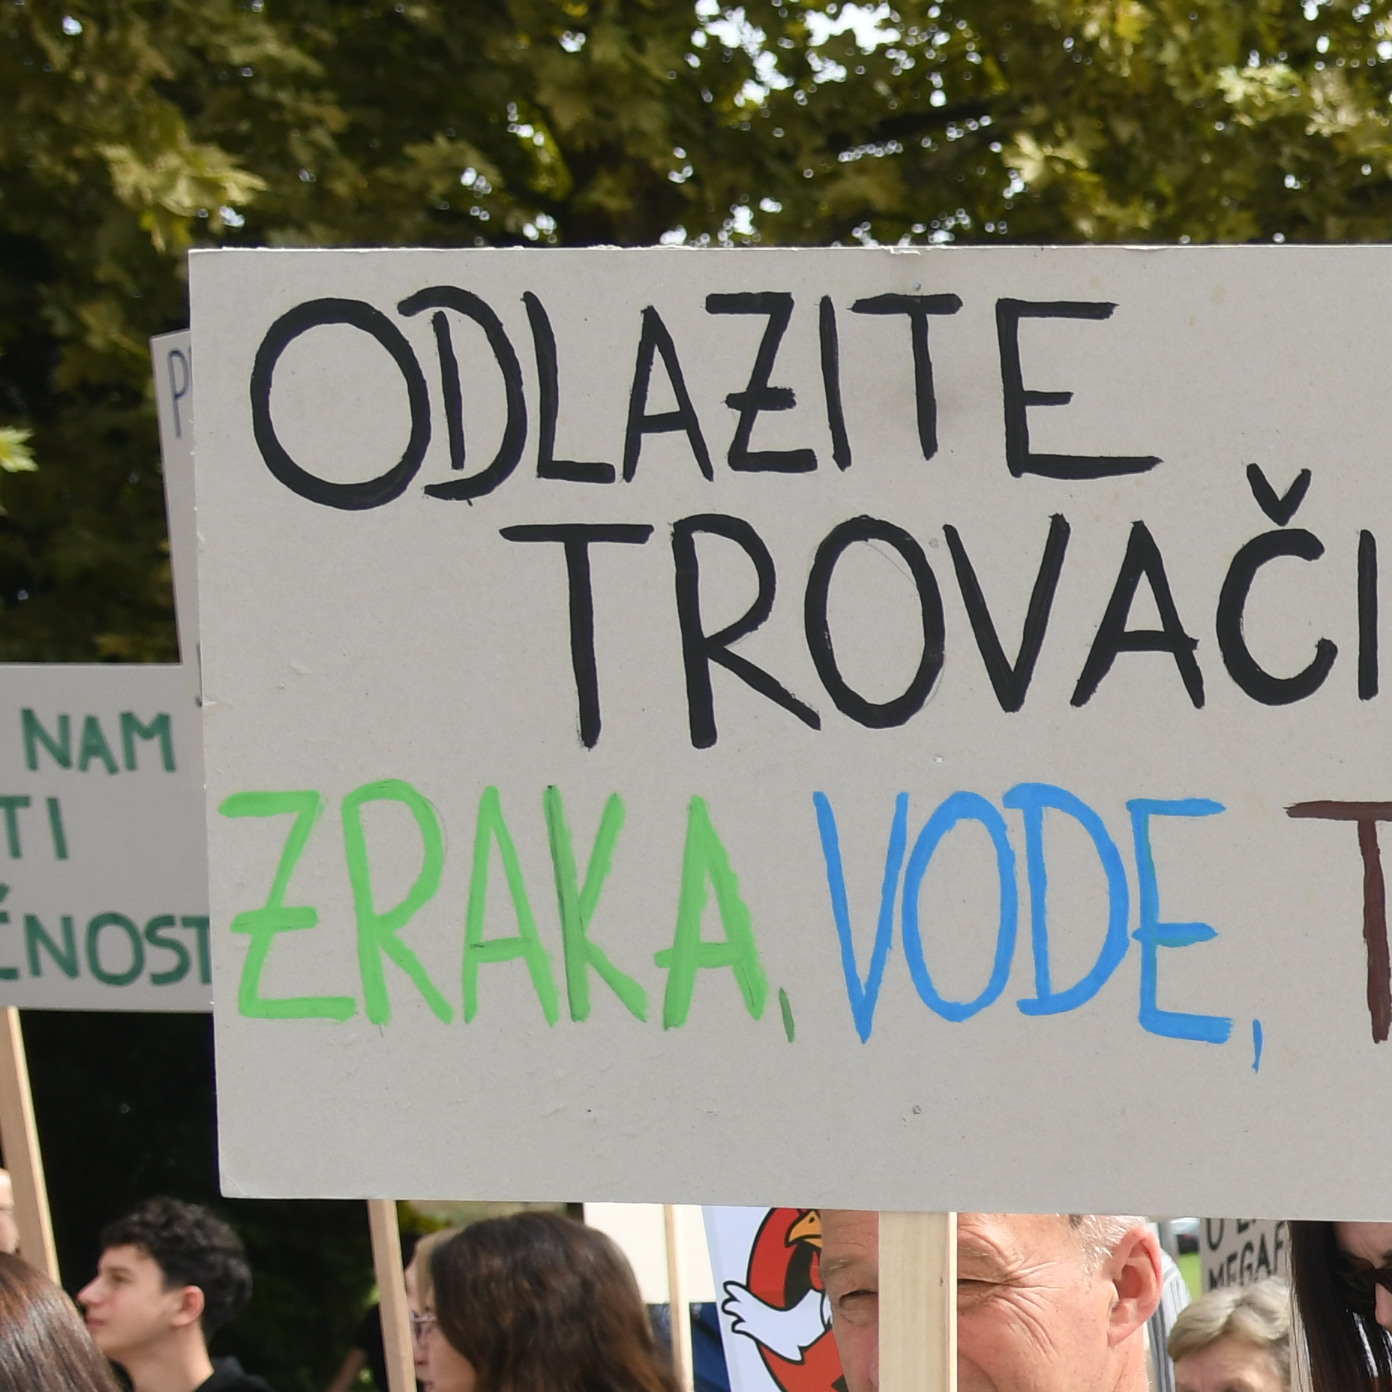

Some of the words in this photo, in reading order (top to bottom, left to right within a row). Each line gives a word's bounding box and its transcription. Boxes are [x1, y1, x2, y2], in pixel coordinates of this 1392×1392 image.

[250, 285, 1163, 511] ODLAZITE
[499, 463, 1379, 750] TROVAČI
[21, 708, 177, 775] NAM
[218, 779, 798, 1043] ZRAKA,
[812, 782, 1263, 1073] VODE,
